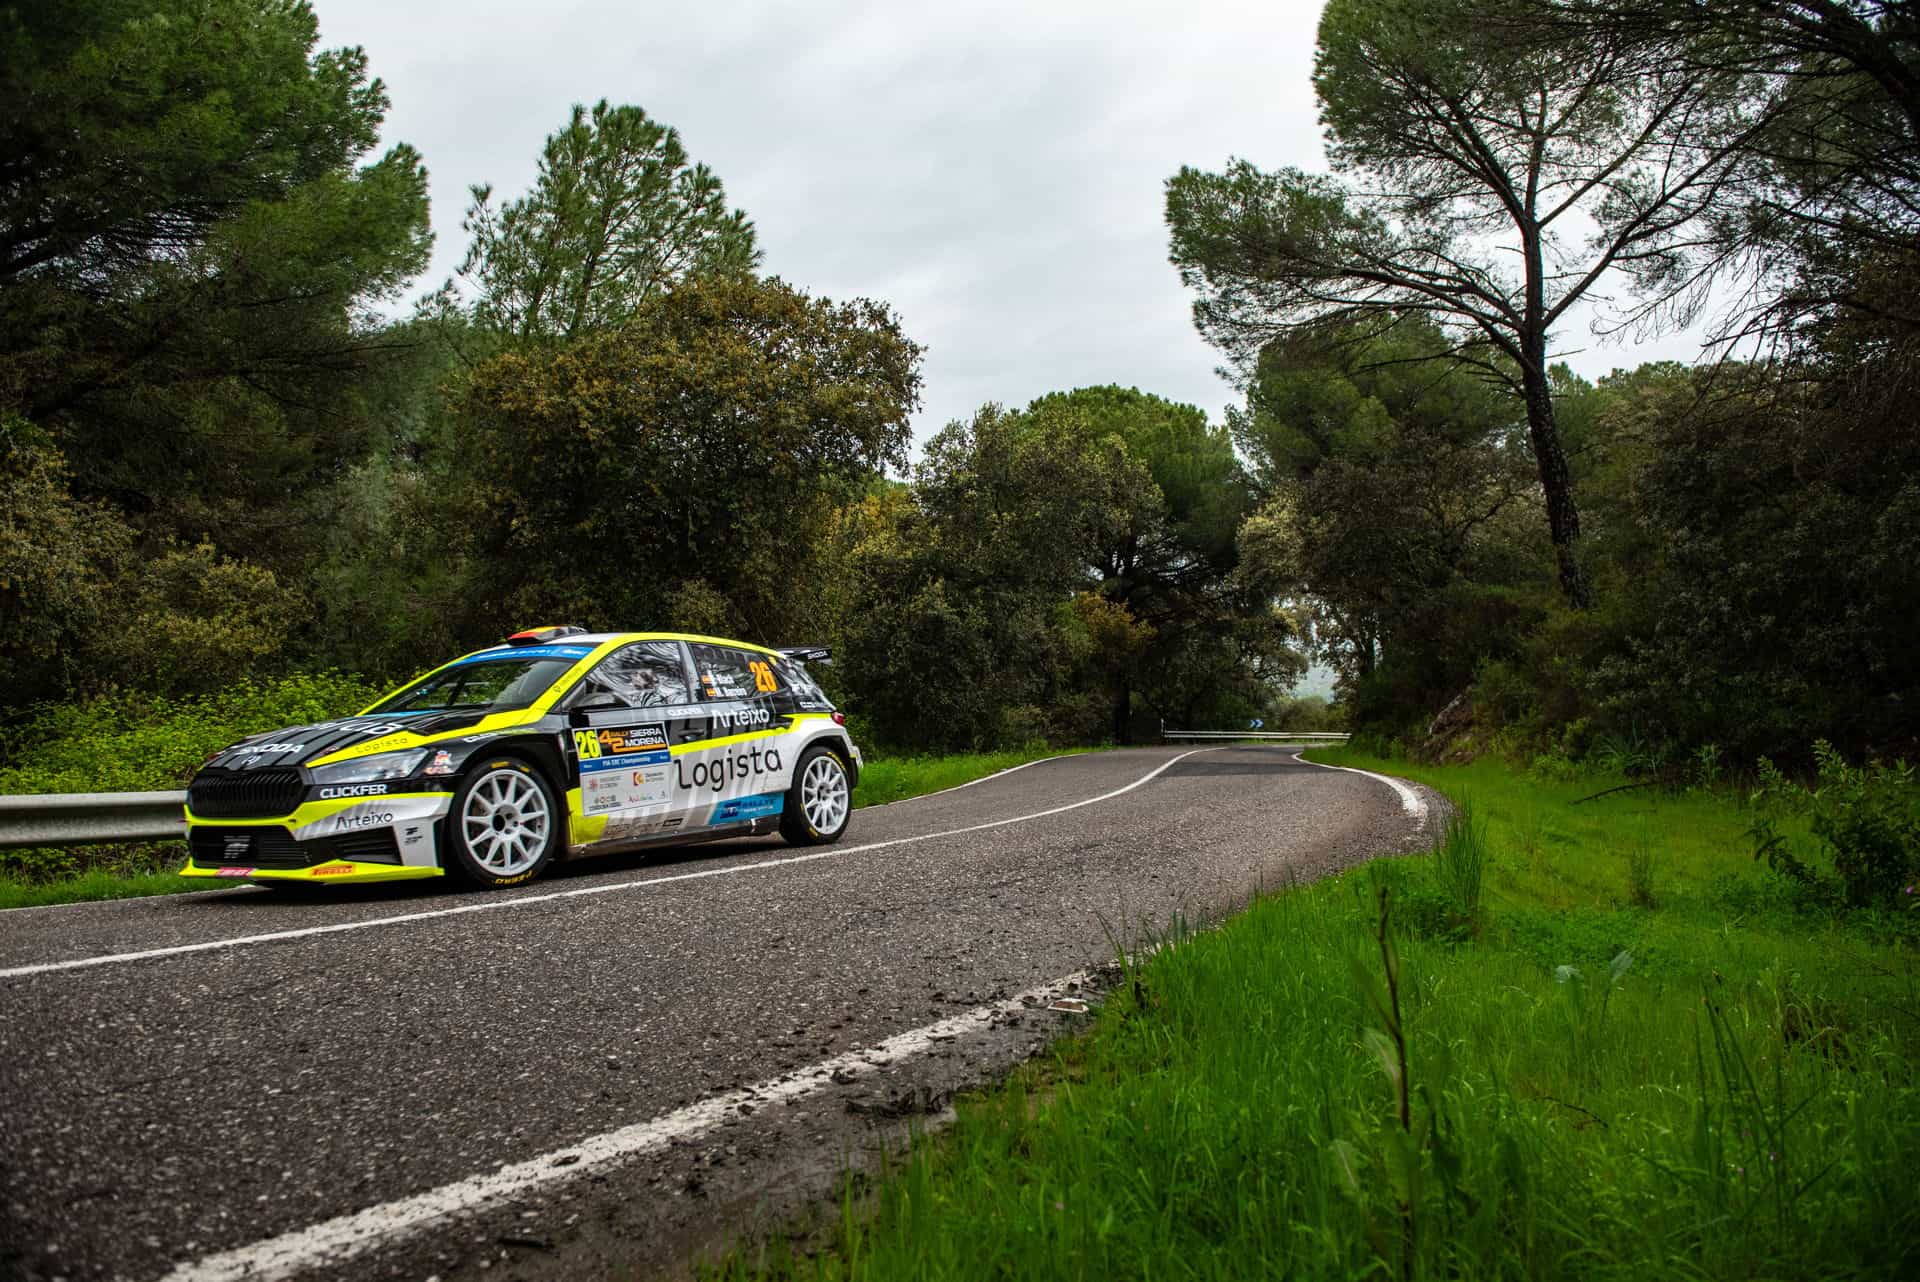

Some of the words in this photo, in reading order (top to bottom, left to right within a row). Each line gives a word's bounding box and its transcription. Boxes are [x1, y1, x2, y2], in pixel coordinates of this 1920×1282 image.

[748, 661, 777, 692] 26
[711, 708, 770, 729] Arteixo
[624, 737, 664, 746] MORENA
[629, 728, 662, 738] SIERRA
[575, 730, 599, 759] 26
[674, 746, 783, 792] Logista
[320, 783, 388, 799] CLICKFER
[335, 811, 393, 830] Arteixo
